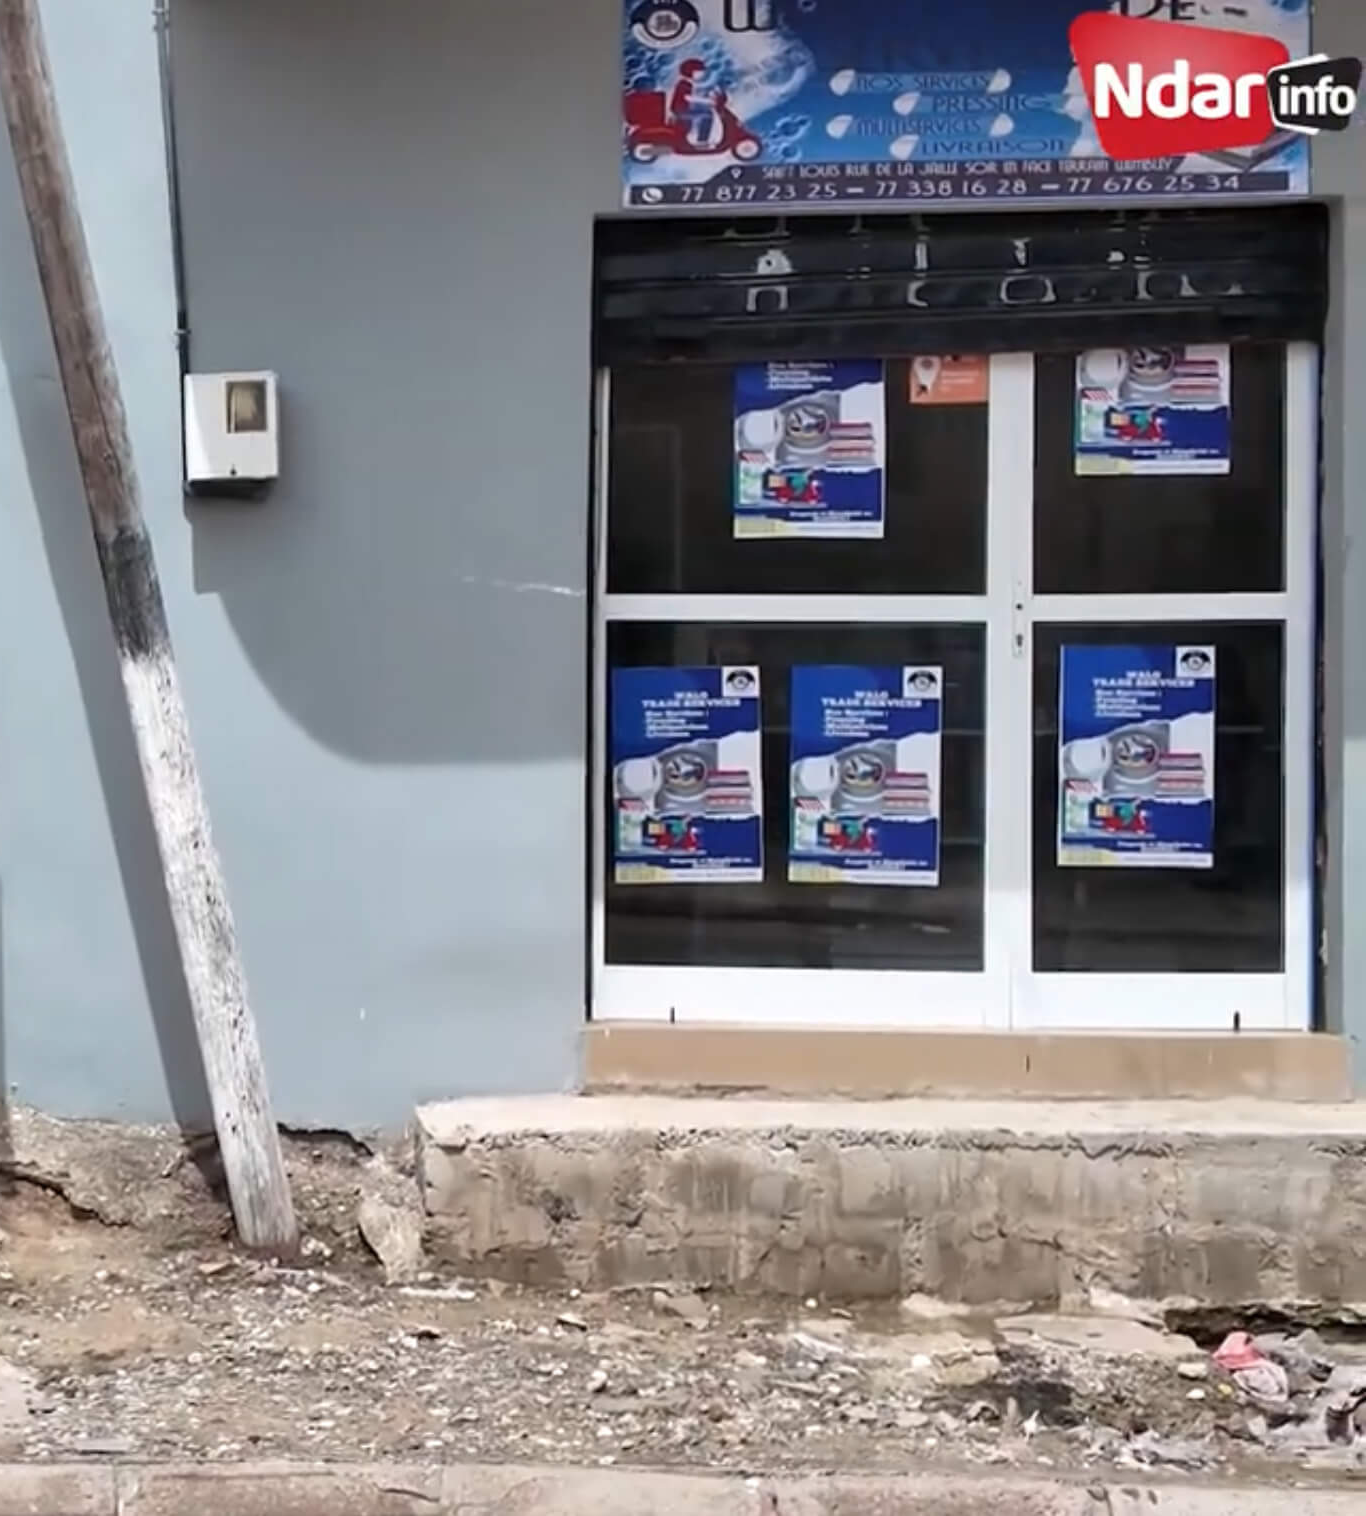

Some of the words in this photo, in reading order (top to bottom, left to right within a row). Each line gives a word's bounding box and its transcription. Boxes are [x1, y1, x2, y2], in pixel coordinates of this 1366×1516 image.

[914, 73, 990, 90] SERVICES
[932, 94, 1052, 114] PRESSING
[922, 138, 1064, 156] LIVRAISON
[799, 163, 841, 178] LOUIS
[845, 163, 870, 177] RUE
[875, 163, 892, 176] DE
[897, 162, 915, 176] LA
[681, 186, 703, 202] 77
[715, 185, 756, 201] 877
[766, 184, 797, 200] 23
[809, 183, 837, 199] 25
[875, 181, 897, 197] 77
[905, 180, 952, 196] 338
[962, 178, 986, 195] 16
[996, 178, 1027, 194] 28
[1067, 177, 1091, 193] 77
[1103, 176, 1153, 192] 676
[1163, 175, 1195, 191] 25
[1205, 174, 1240, 190] 34
